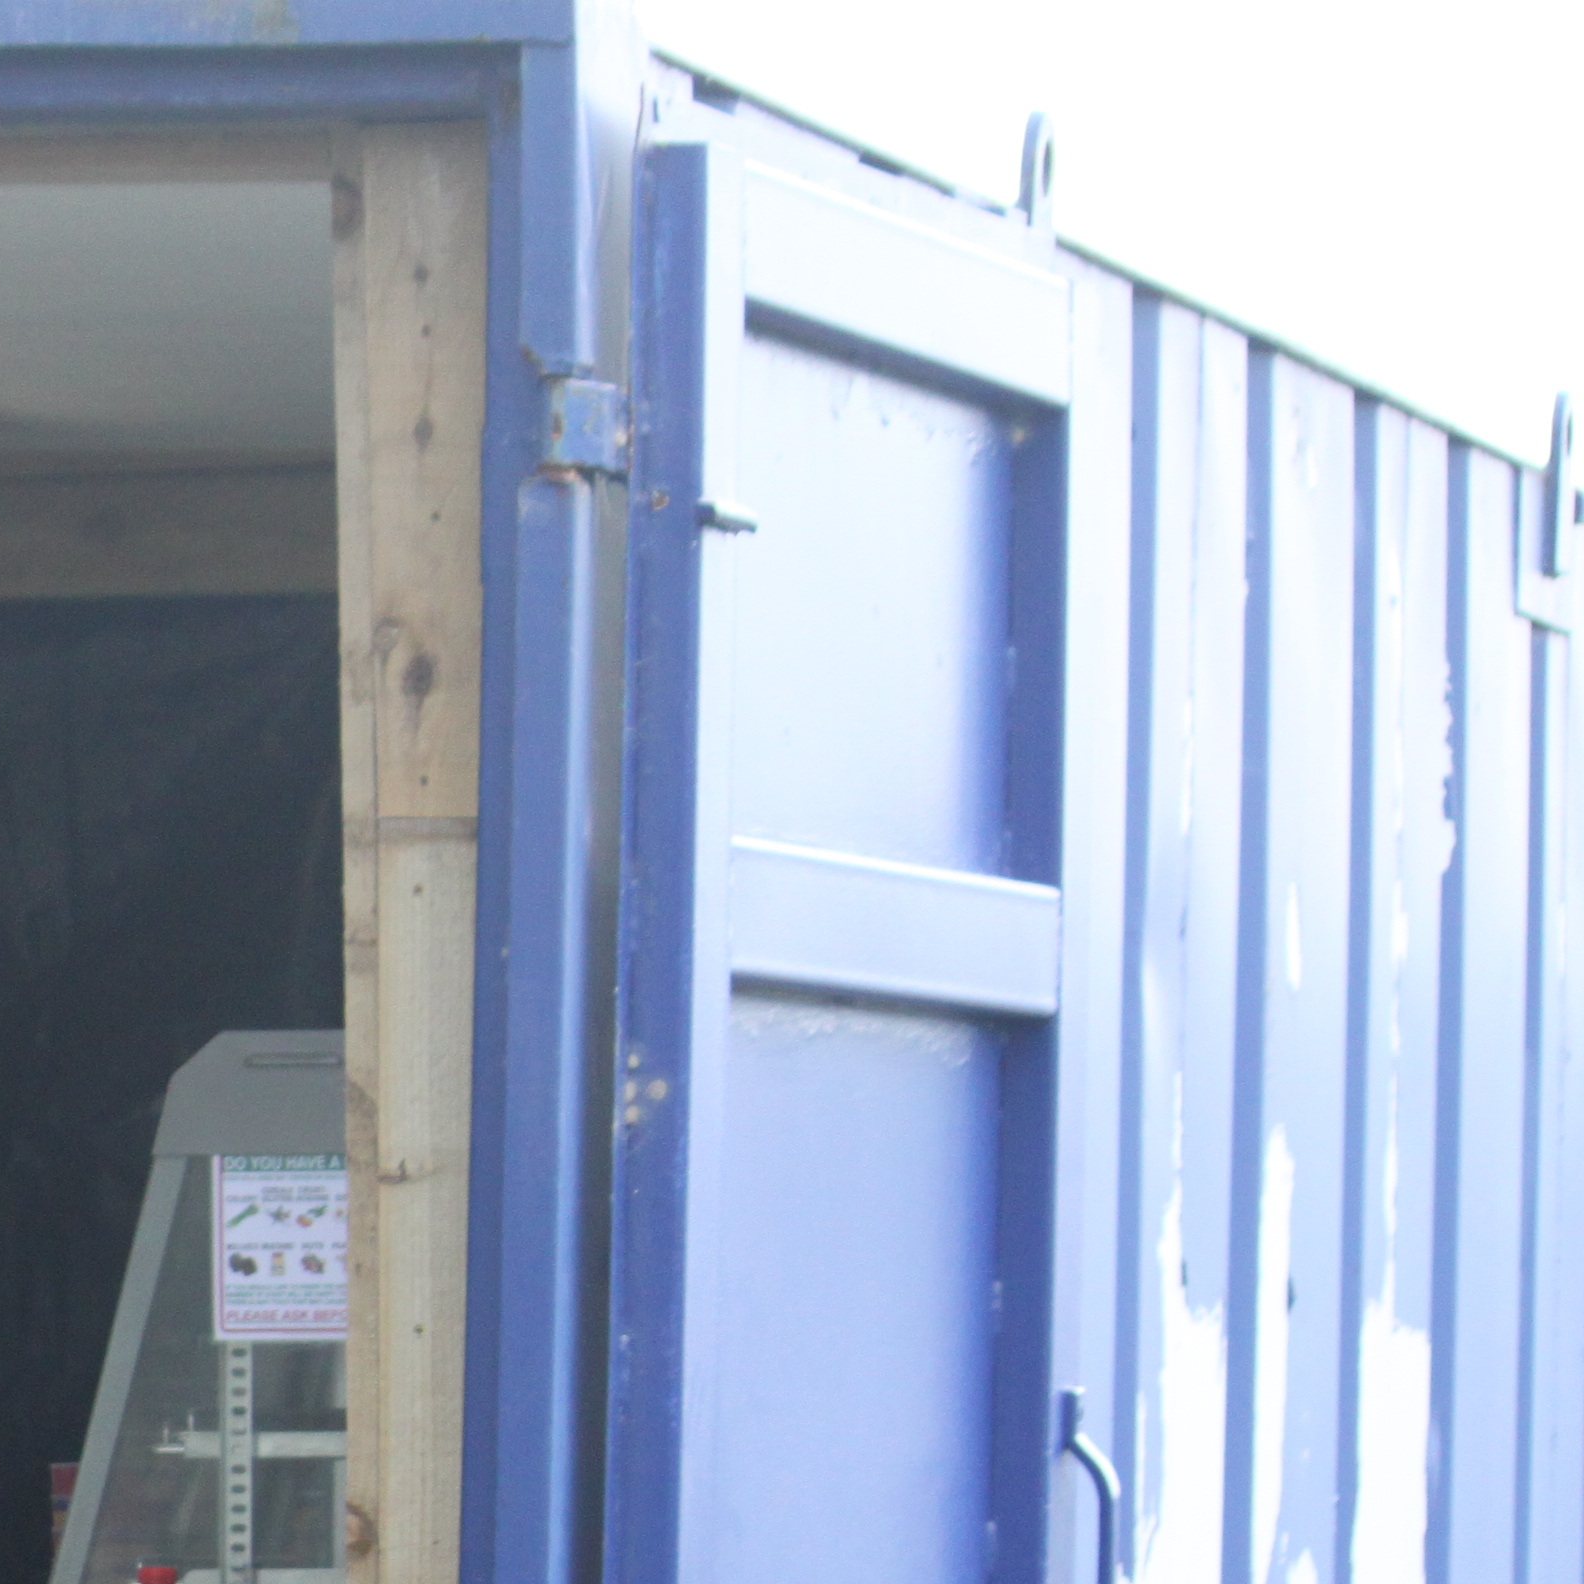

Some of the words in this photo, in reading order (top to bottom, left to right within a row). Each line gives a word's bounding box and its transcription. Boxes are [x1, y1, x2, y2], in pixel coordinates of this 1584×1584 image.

[224, 1155, 247, 1170] DO
[252, 1155, 283, 1170] YOU
[286, 1154, 327, 1169] HAVE
[330, 1154, 341, 1168] A
